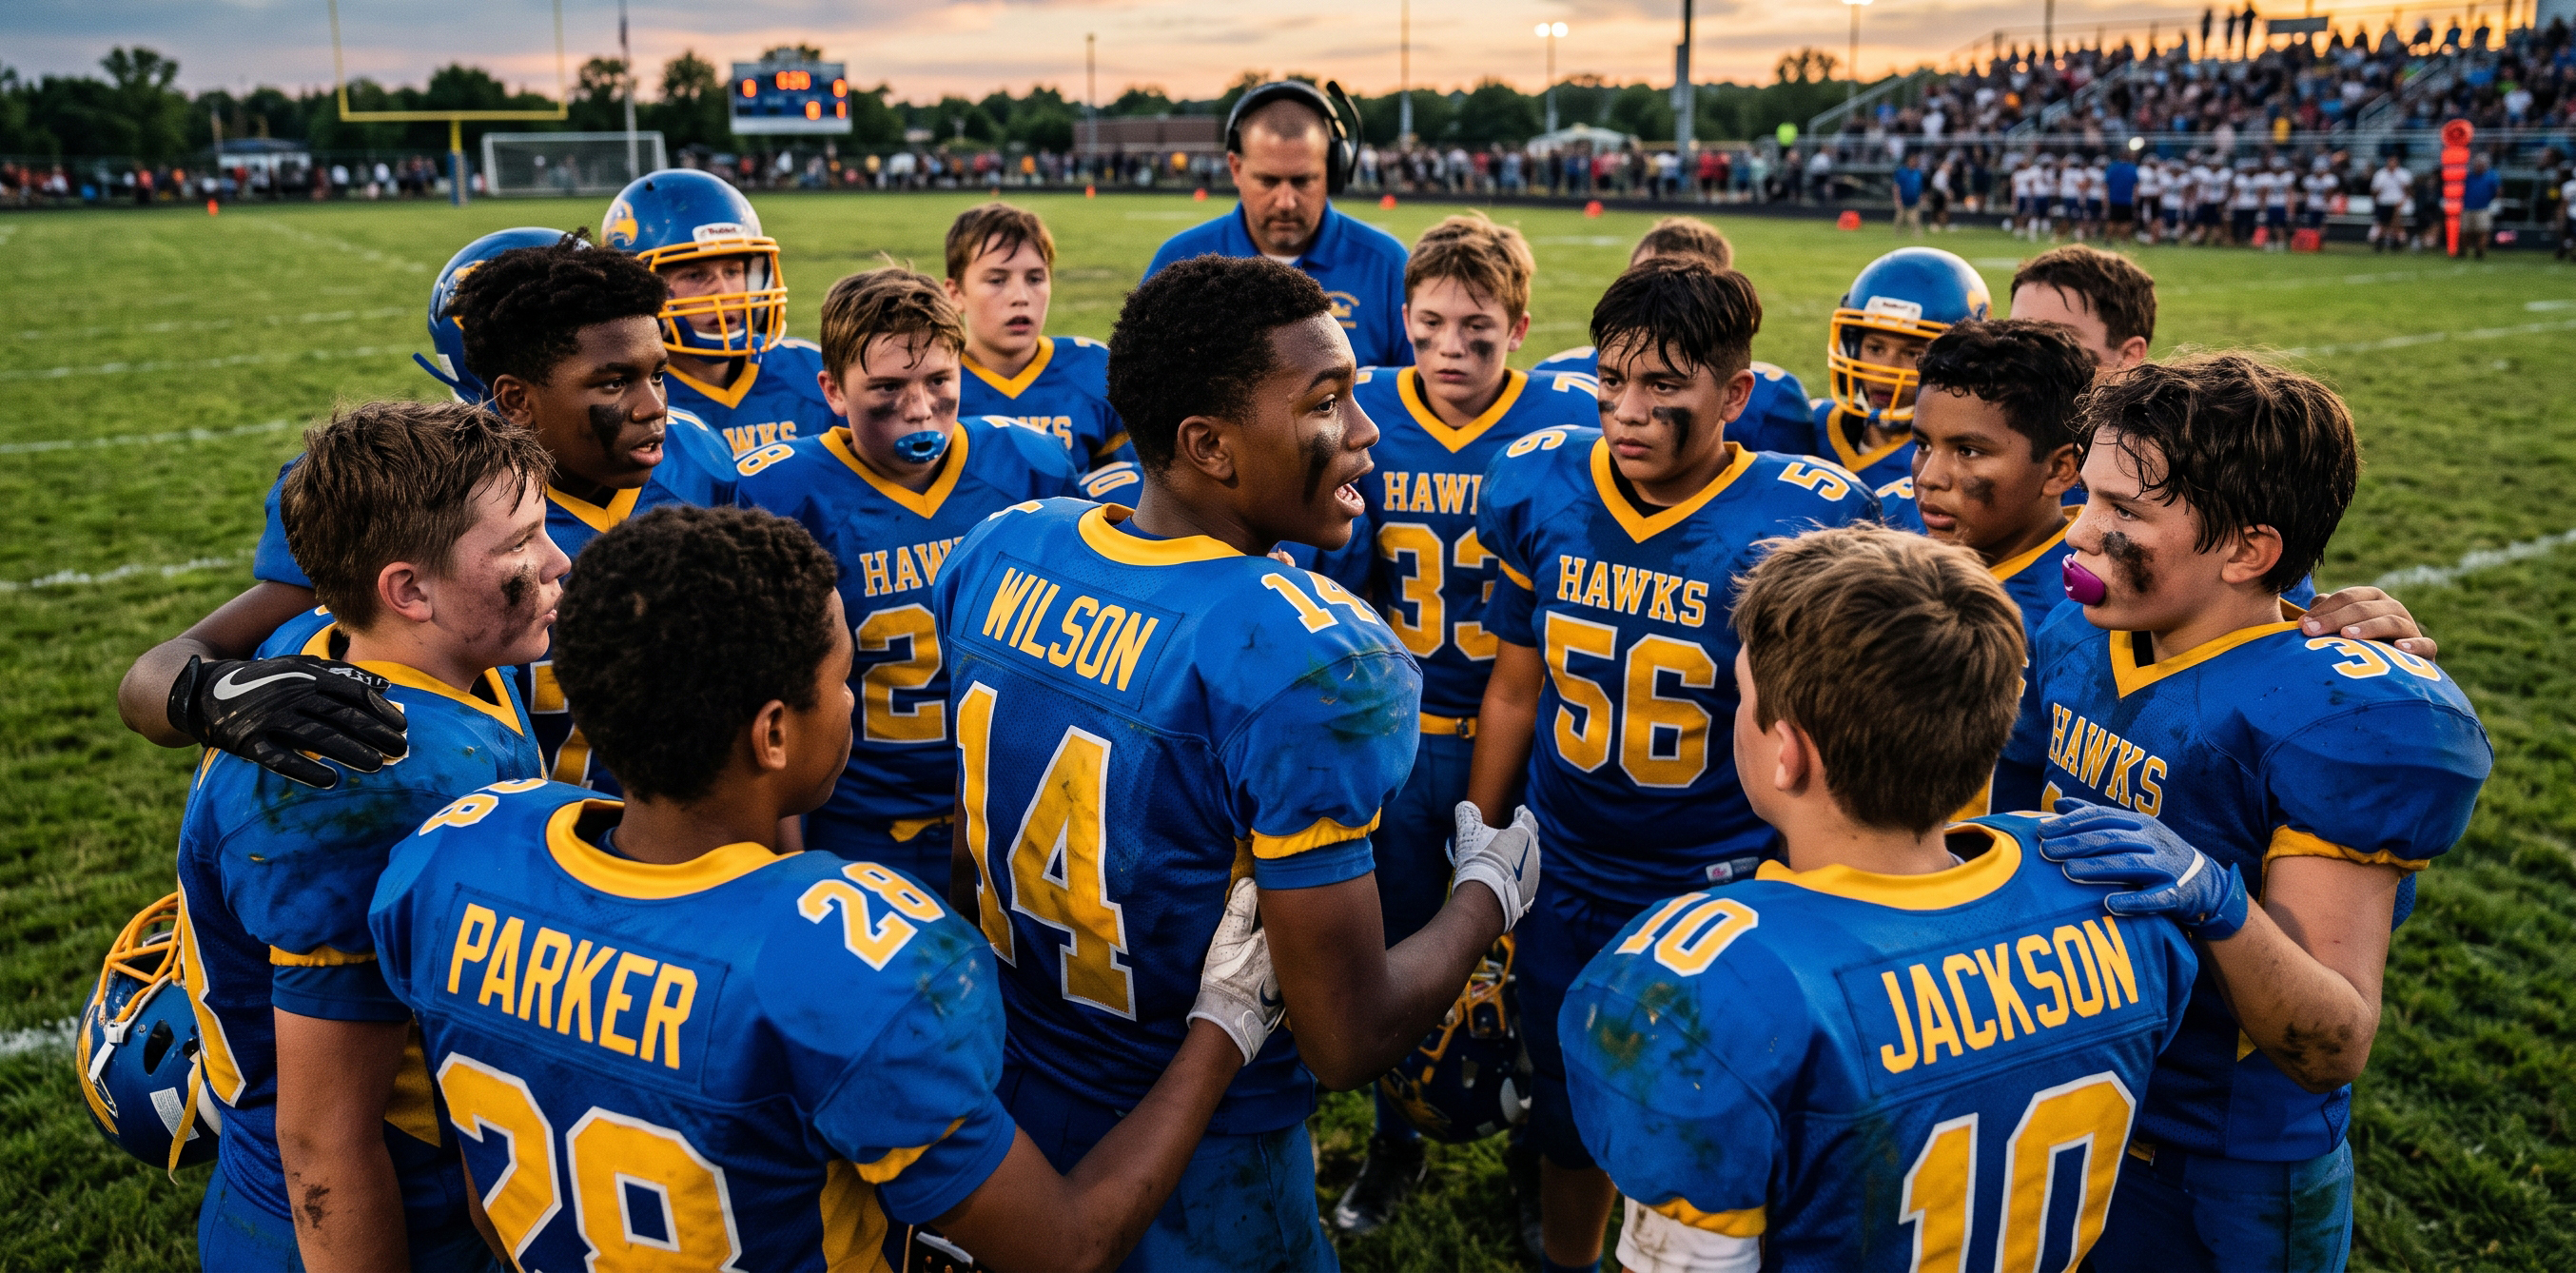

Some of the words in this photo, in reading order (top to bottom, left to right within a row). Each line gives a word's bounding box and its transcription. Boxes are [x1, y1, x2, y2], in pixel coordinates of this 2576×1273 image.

[722, 421, 797, 462] WKS
[735, 442, 796, 477] 8
[1382, 471, 1484, 516] HAW
[859, 536, 965, 597] HAW
[1260, 571, 1380, 634] 14
[1376, 521, 1502, 661] 33
[1556, 555, 1709, 628] HAWKS
[855, 602, 947, 744] 2
[982, 567, 1160, 692] WILSON
[1544, 610, 1718, 789] 56
[2048, 702, 2168, 818] HAWKS
[956, 679, 1137, 1022] 14
[796, 861, 946, 972] 28
[1613, 891, 1760, 978] 10
[447, 902, 698, 1070] PARKER
[1880, 915, 2139, 1074] JACKSON
[436, 1051, 750, 1273] 28
[1899, 1070, 2137, 1273] 10
